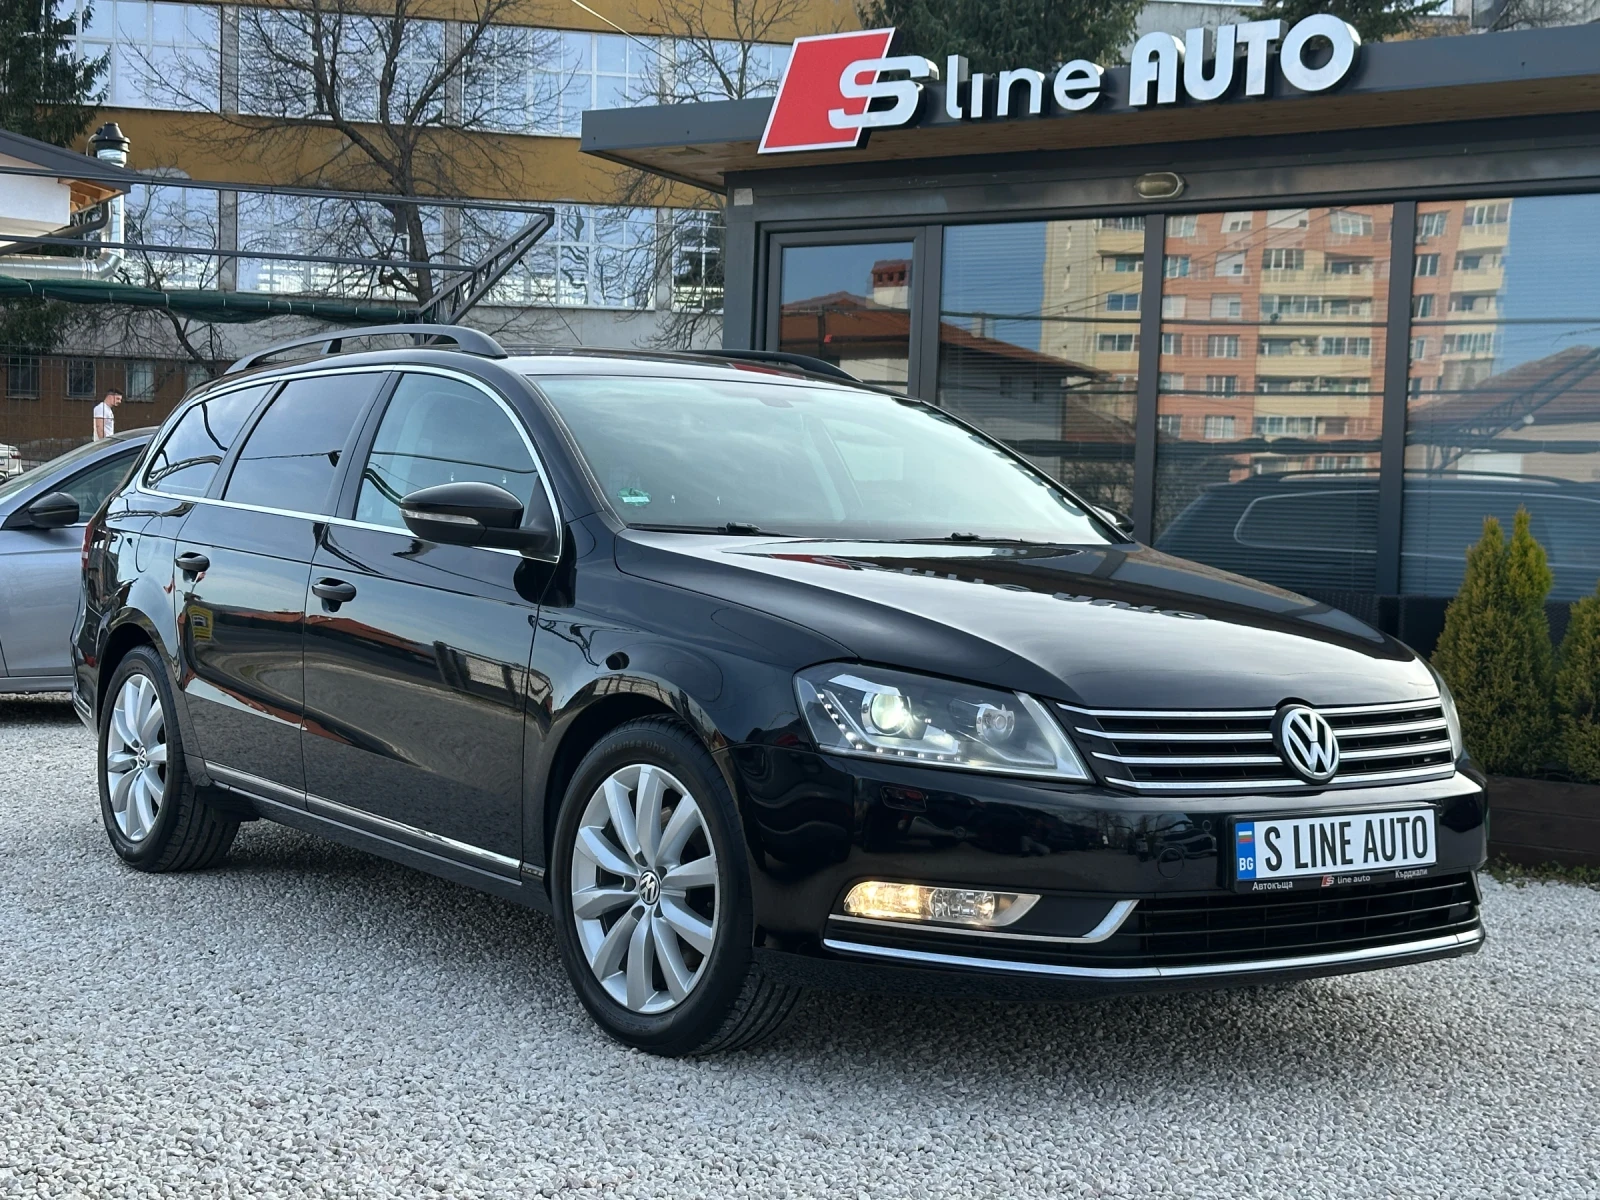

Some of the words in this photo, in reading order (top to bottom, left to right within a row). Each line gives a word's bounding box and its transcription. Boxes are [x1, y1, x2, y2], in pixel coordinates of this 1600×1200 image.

[828, 55, 935, 129] S
[946, 54, 1102, 119] line
[1129, 13, 1357, 106] AUTO
[1264, 826, 1282, 871] S
[1293, 821, 1354, 869] LINE
[1363, 816, 1428, 863] AUTO
[1239, 857, 1254, 872] BG
[1353, 875, 1371, 883] auto
[1395, 868, 1428, 880] Кърджали
[1252, 881, 1293, 891] Автокъща
